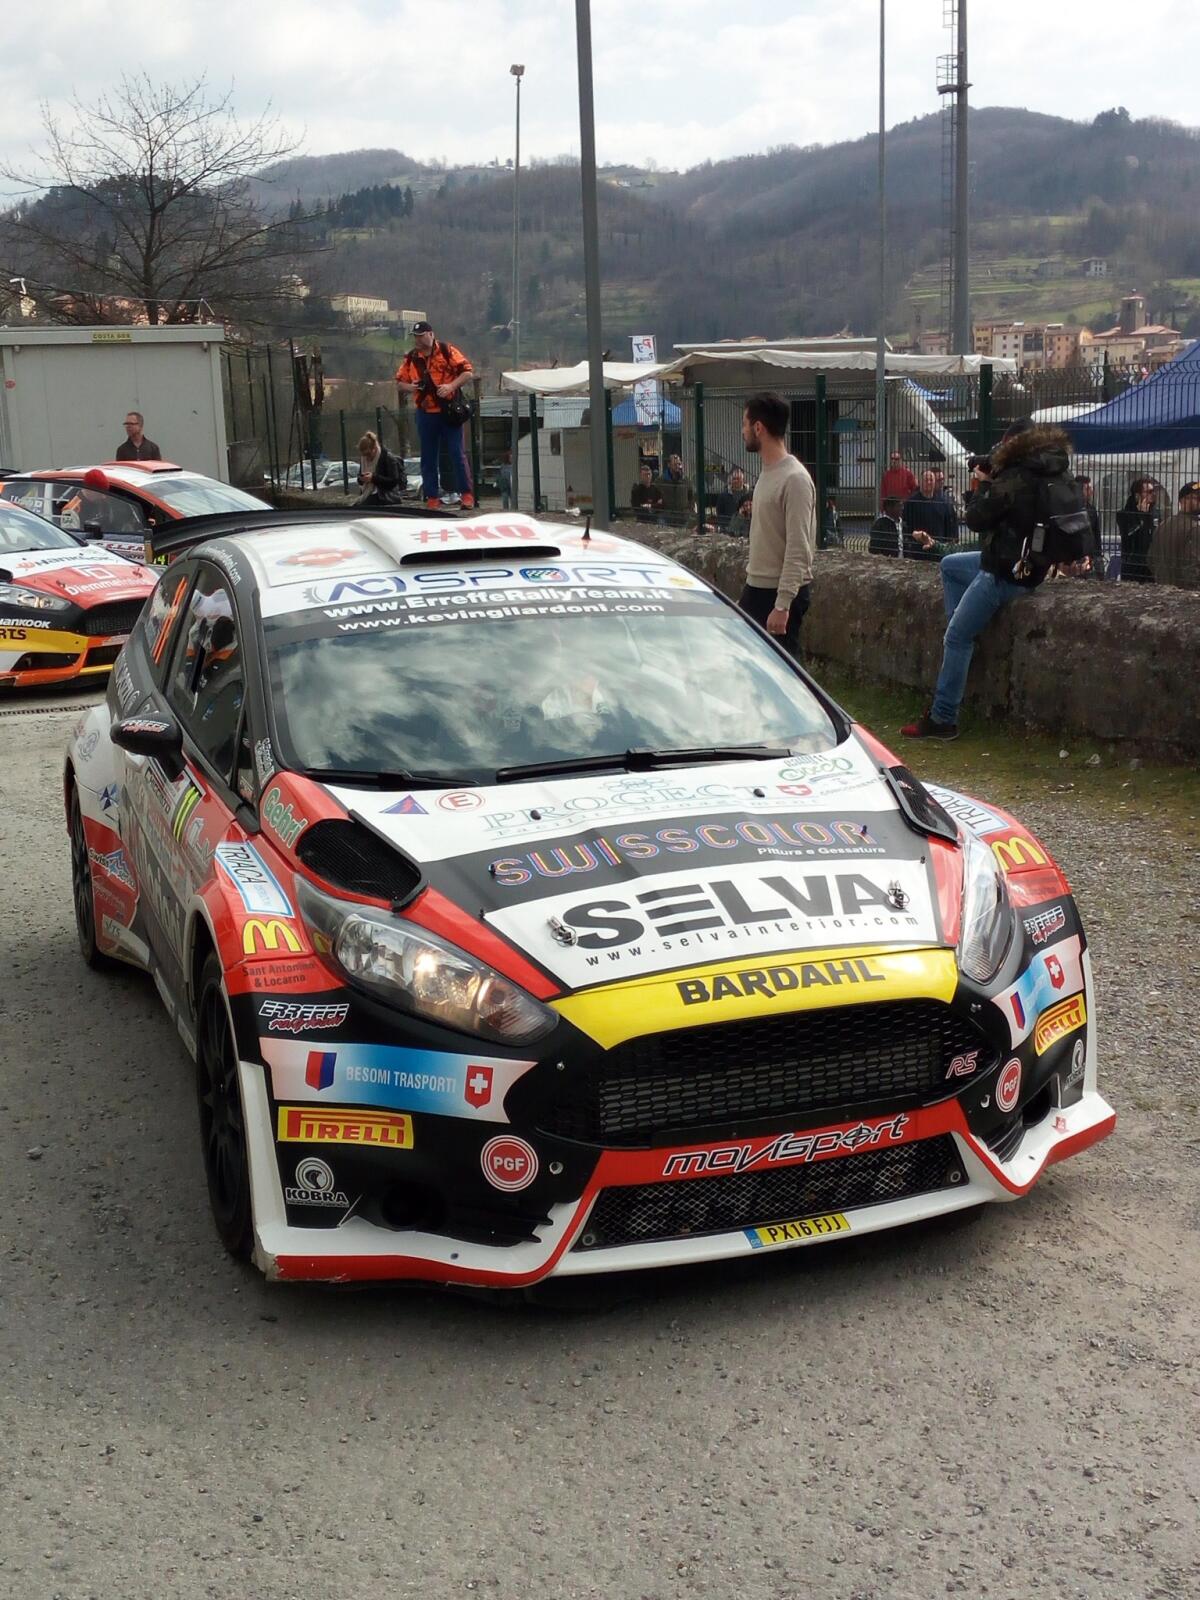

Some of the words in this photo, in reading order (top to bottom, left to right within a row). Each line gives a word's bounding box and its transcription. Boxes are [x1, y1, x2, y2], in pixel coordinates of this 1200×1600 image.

[323, 587, 673, 618] www.ErreffeRallyTeam.it
[338, 604, 664, 631] www.kevingilardoni.com
[218, 846, 267, 883] TRIACA
[757, 848, 802, 856] Pittura
[818, 846, 886, 855] Gessatura
[563, 873, 909, 951] SELVA
[585, 915, 920, 968] www.selvainterior.com
[264, 974, 306, 987] Locarno
[676, 958, 886, 1006] BARDAHL
[1036, 995, 1083, 1051] PIRELLI
[946, 1051, 982, 1079] RS
[346, 1066, 390, 1086] BESOMI
[393, 1071, 456, 1093] TRASPORTI
[1004, 1074, 1018, 1096] PGF
[287, 1110, 405, 1144] PIRELLI
[493, 1156, 525, 1172] PGF
[285, 1187, 349, 1203] KOBRA
[767, 1221, 812, 1242] PX16
[813, 1215, 842, 1233] FJJ
